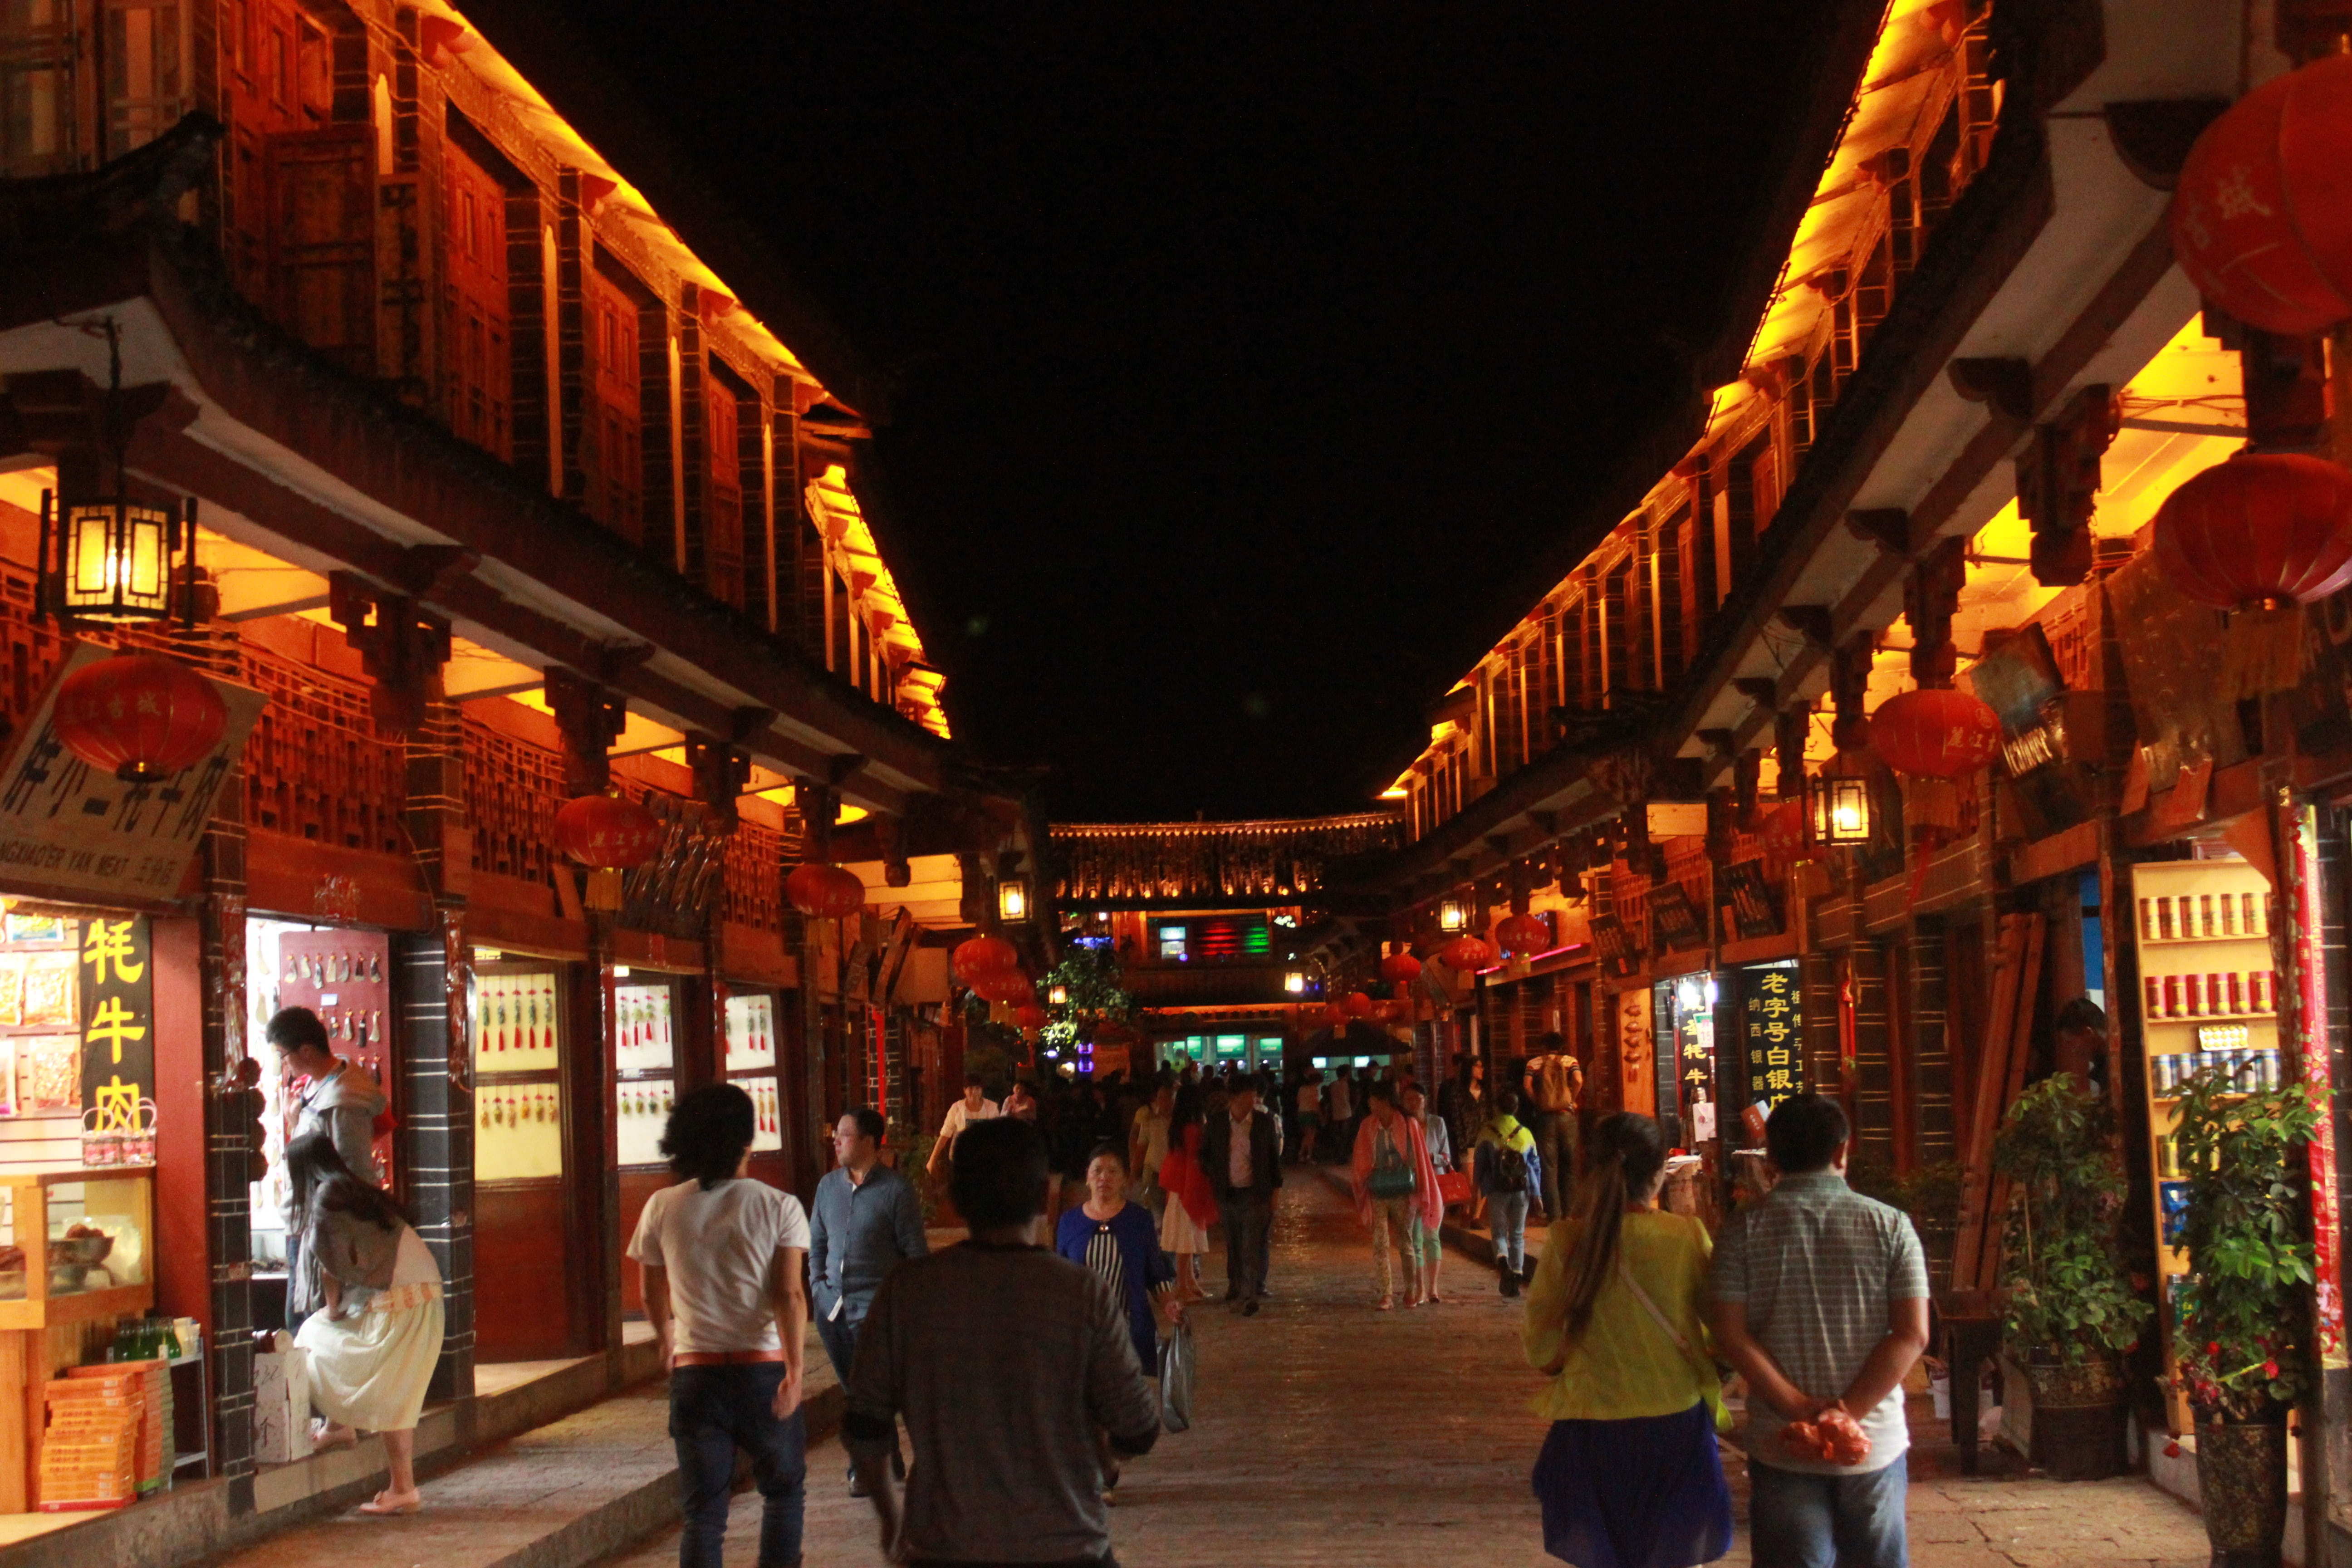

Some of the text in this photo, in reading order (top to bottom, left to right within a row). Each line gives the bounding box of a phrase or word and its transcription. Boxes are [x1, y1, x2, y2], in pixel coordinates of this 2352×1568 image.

[68, 850, 94, 873] YAK
[94, 854, 130, 877] MEAT
[83, 918, 146, 1132] 牦牛肉
[1700, 1030, 1711, 1041] 15
[1748, 997, 1764, 1091] 纳西银器
